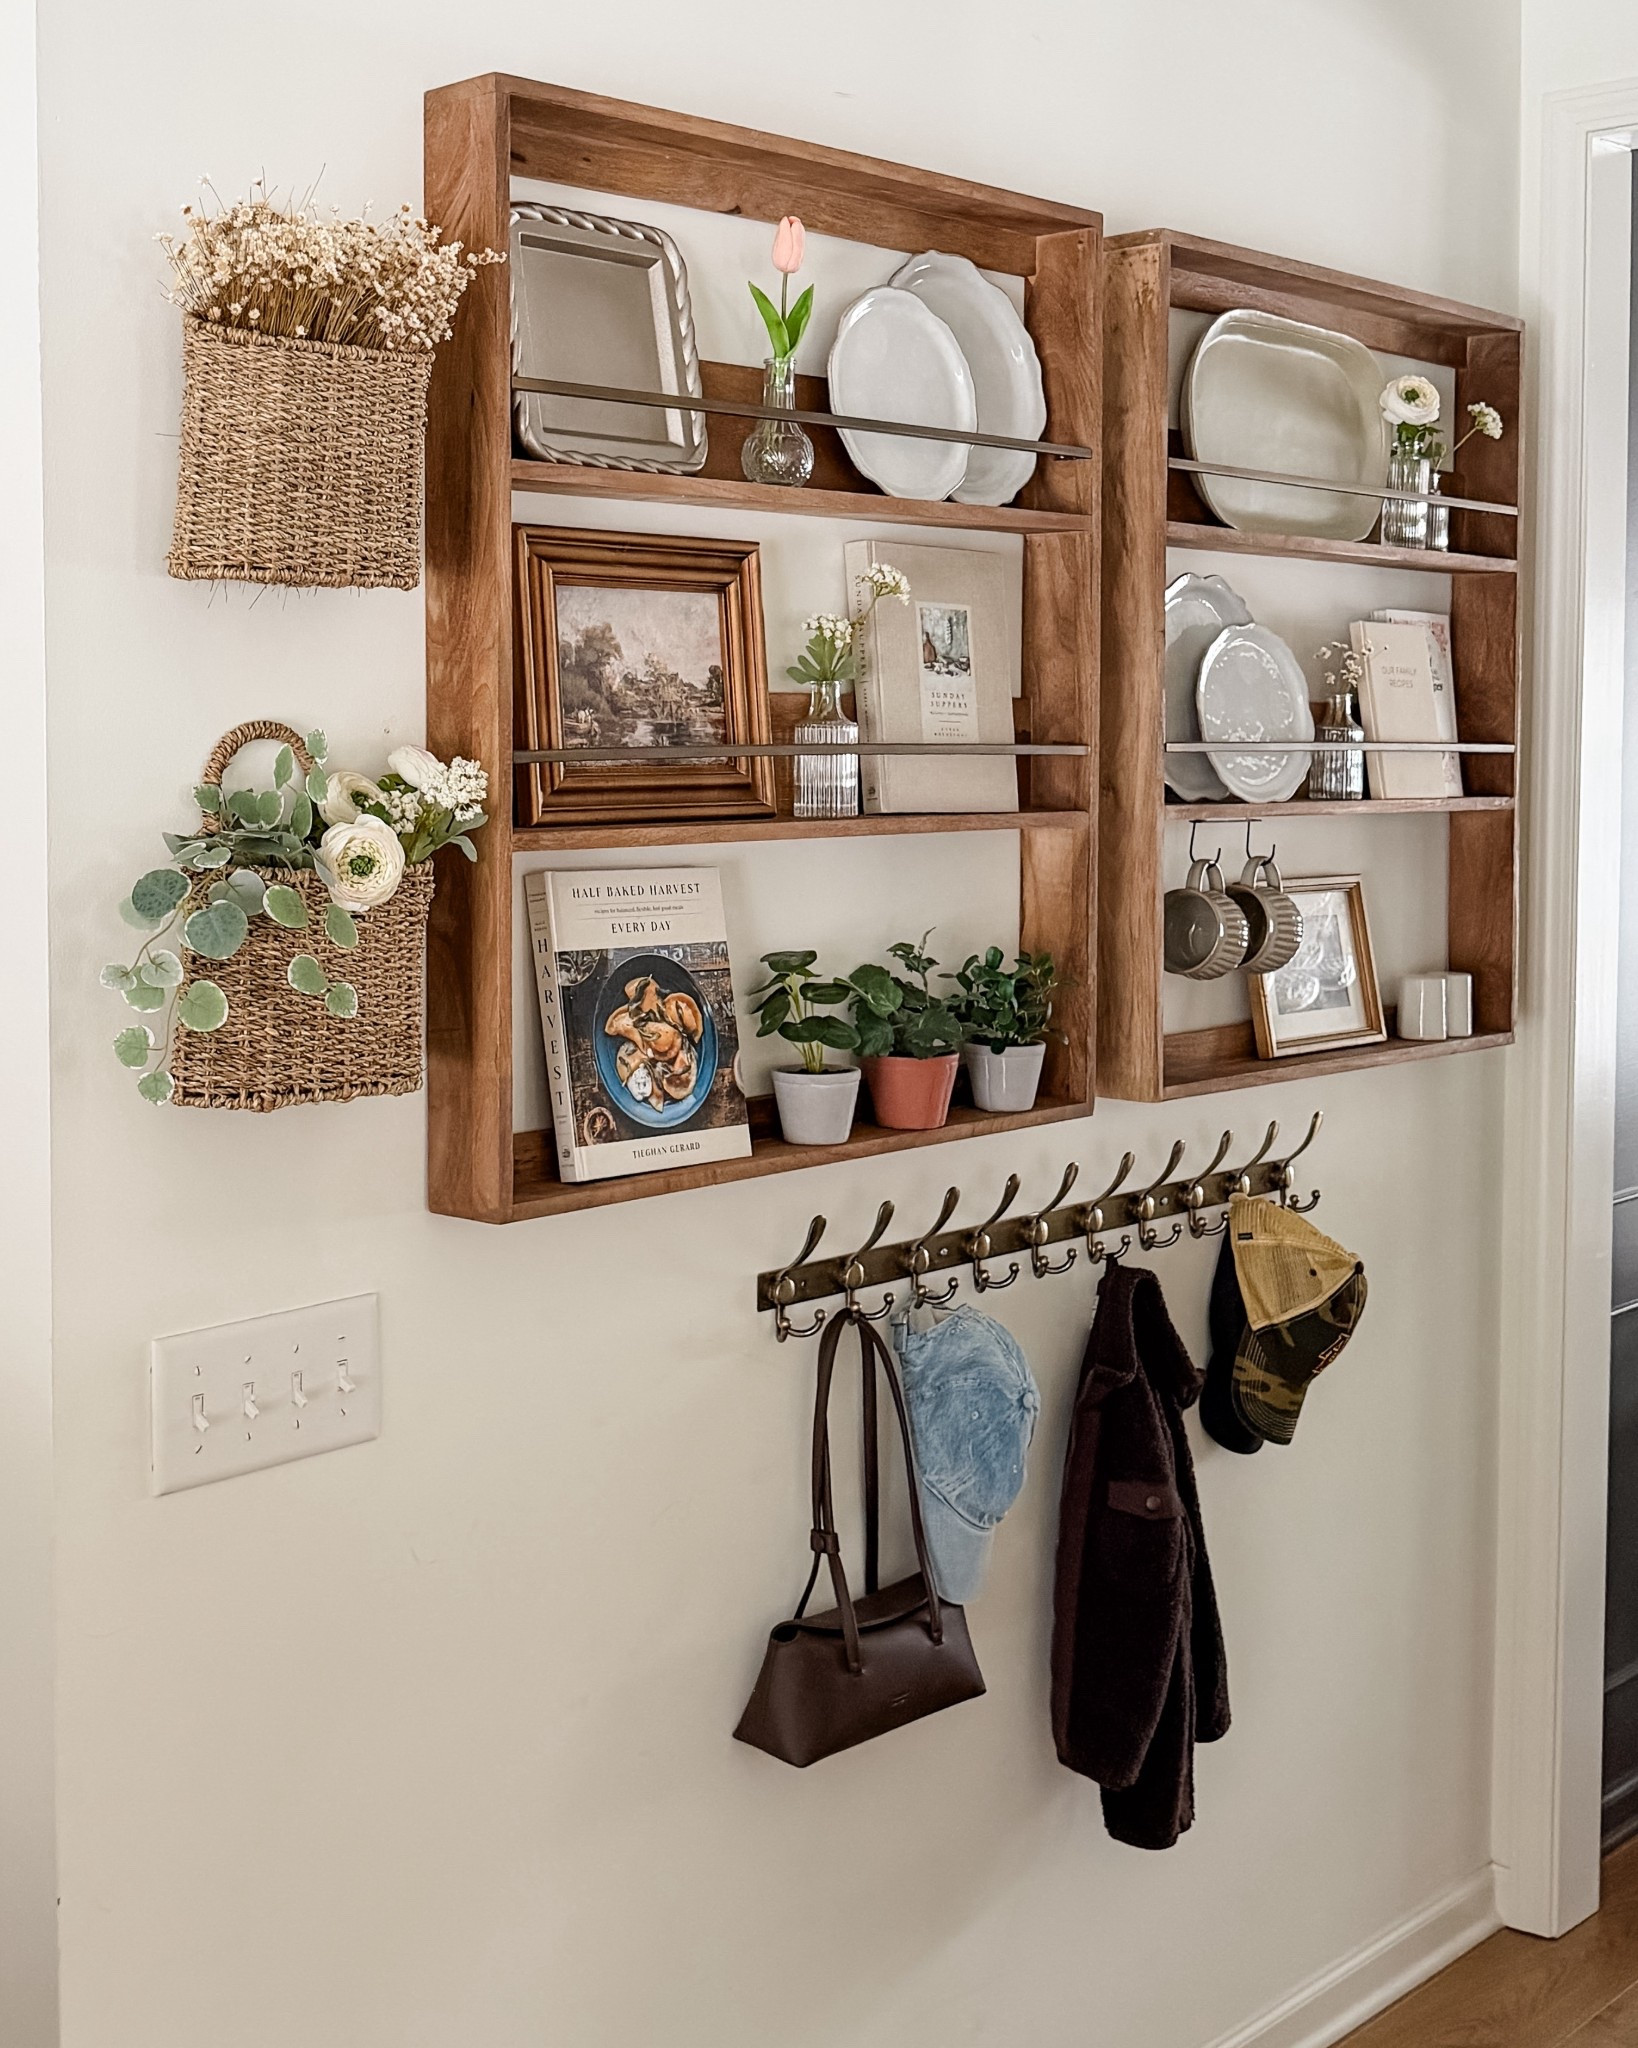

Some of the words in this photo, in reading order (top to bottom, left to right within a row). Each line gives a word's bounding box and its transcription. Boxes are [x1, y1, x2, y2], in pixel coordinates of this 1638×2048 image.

[931, 692, 965, 700] SUNDAY
[572, 887, 601, 899] HALF
[607, 885, 645, 897] BAKED
[649, 883, 700, 896] HARVEST
[611, 922, 647, 934] EVERY
[651, 920, 671, 932] DAY
[537, 938, 564, 1106] HARVEST
